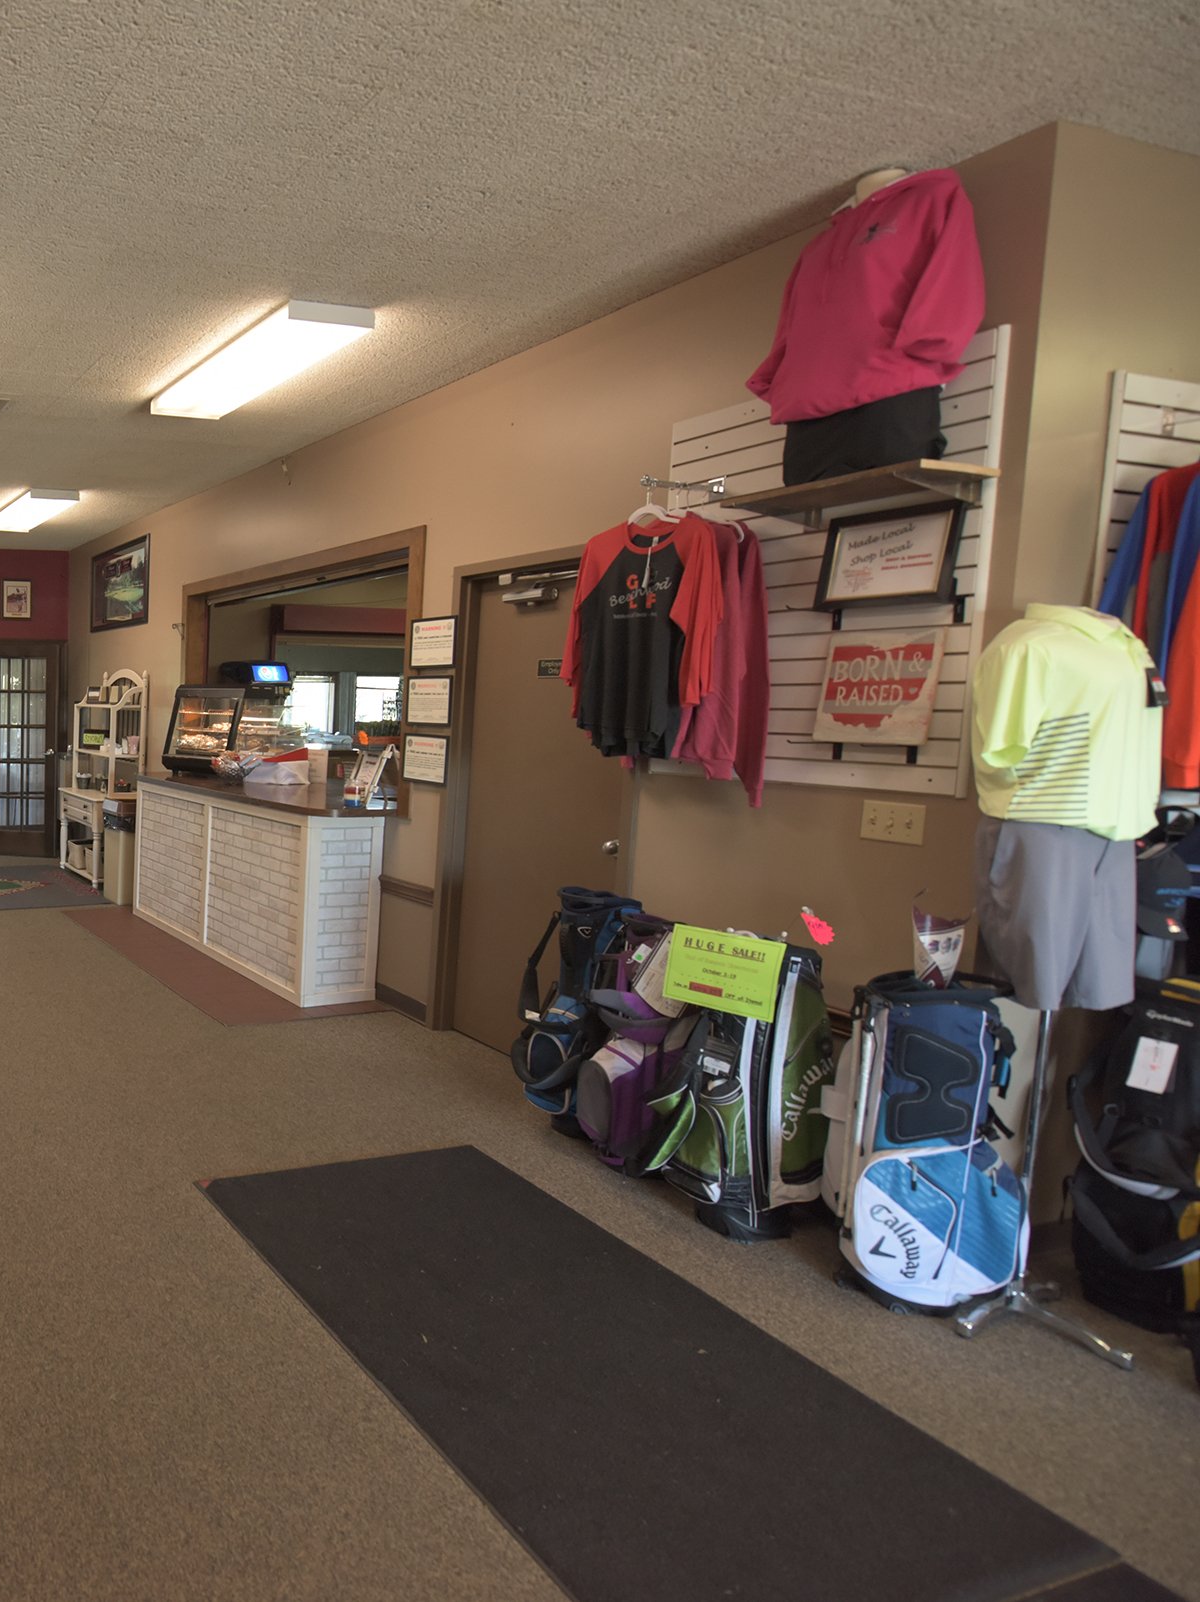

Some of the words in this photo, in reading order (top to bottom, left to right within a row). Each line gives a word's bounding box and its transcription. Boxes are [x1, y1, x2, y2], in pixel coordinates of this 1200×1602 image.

[848, 535, 880, 551] Made
[882, 522, 916, 540] Local
[849, 553, 878, 567] Shop
[880, 540, 914, 557] Local
[833, 650, 905, 683] BORN
[908, 651, 926, 673] &
[835, 684, 904, 707] RAISED
[732, 947, 767, 962] SALE!!
[869, 1204, 920, 1279] Callaway
